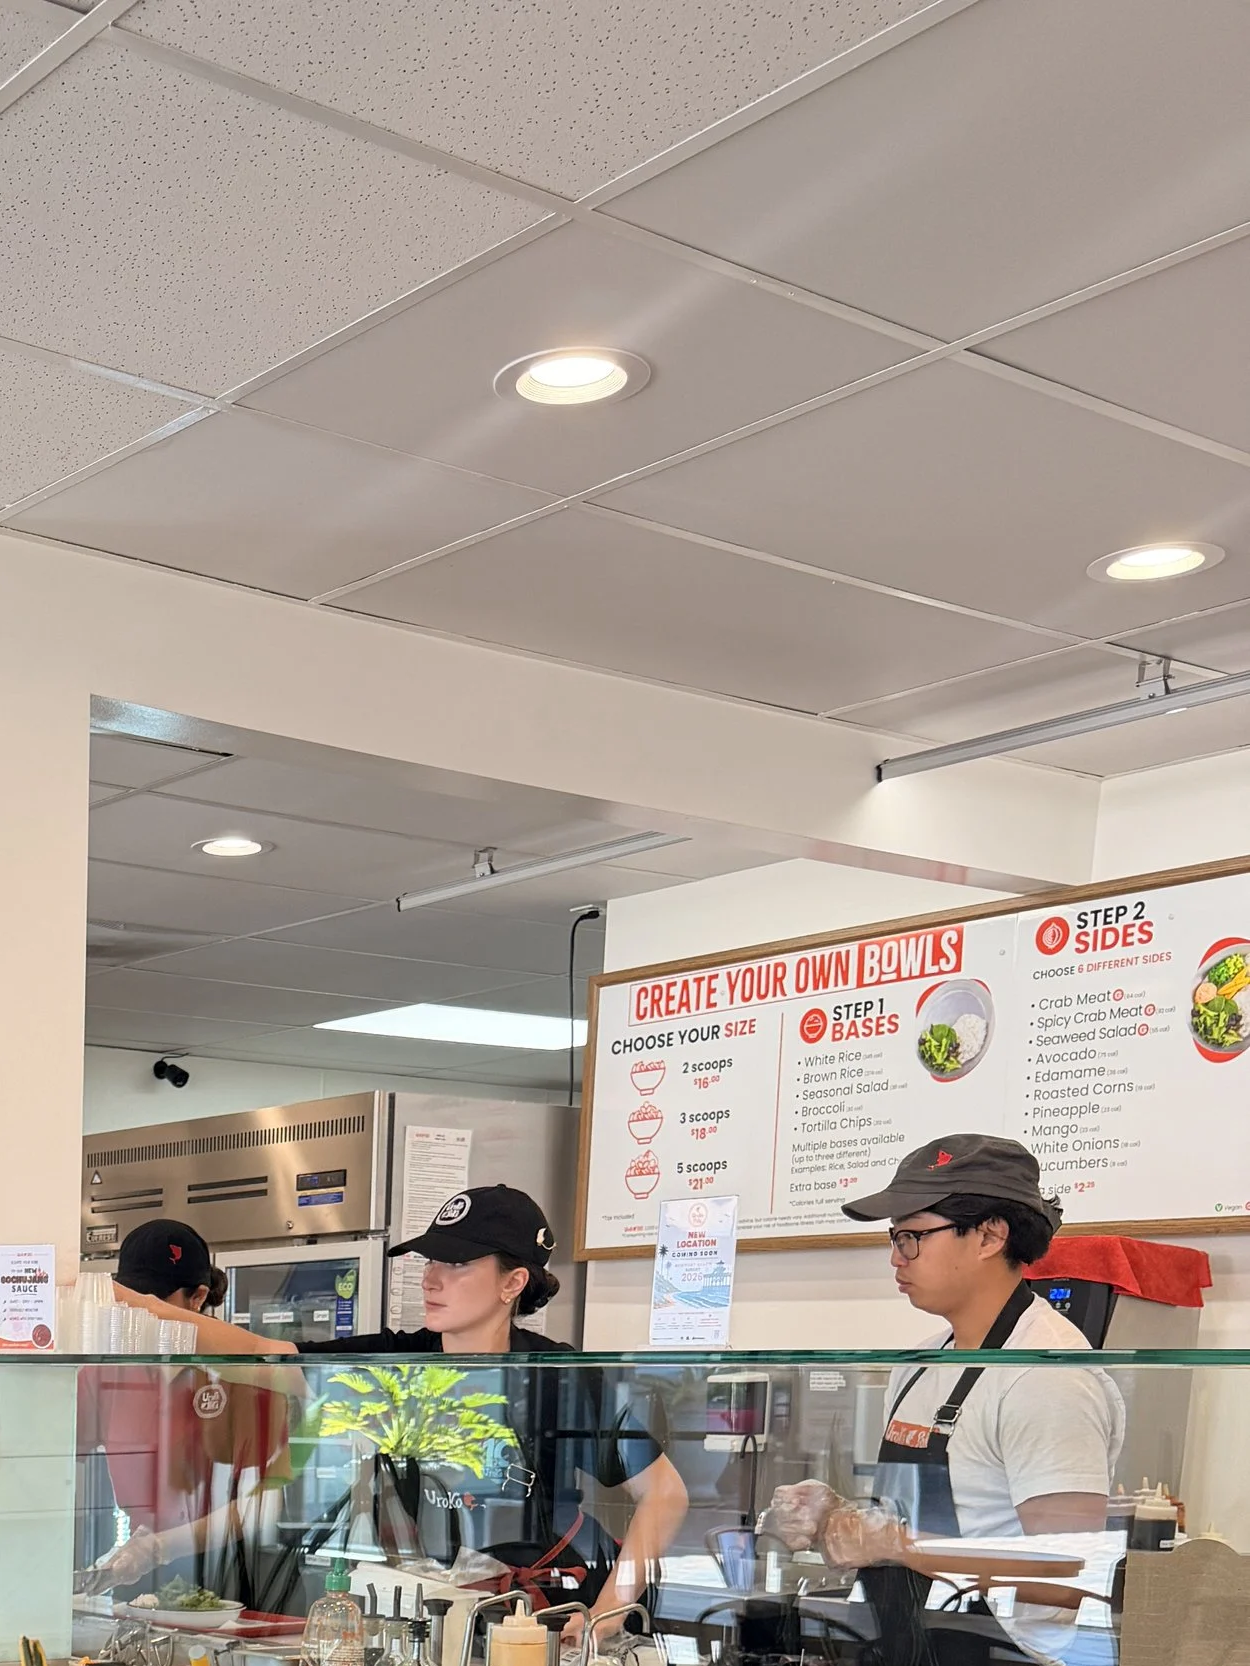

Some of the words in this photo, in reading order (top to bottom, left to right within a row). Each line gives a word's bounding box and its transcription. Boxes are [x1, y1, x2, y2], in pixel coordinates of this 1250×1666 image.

[1076, 905, 1127, 929] STEP
[1133, 901, 1145, 920] 2
[1074, 920, 1153, 954] SIDES
[1033, 965, 1075, 980] CHOOSE
[1078, 964, 1084, 973] 6
[1086, 956, 1140, 973] DIFFERENT
[1142, 951, 1172, 965] SIDES
[635, 973, 719, 1021] CREATE
[725, 962, 787, 1006] YOUR
[794, 948, 850, 993] OWN
[859, 929, 959, 983] BOWLS
[1038, 994, 1072, 1010] Crab
[1076, 990, 1111, 1005] Meat
[833, 1000, 875, 1021] STEP
[879, 998, 885, 1015] 1
[1037, 1014, 1071, 1031] Spicy
[1074, 1008, 1106, 1024] Crab
[1109, 1005, 1143, 1020] Meat
[611, 1031, 675, 1055] CHOOSE
[678, 1024, 721, 1044] YOUR
[724, 1018, 756, 1038] SIZE
[831, 1013, 900, 1043] BASES
[1036, 1028, 1096, 1047] Seaweed
[1099, 1023, 1137, 1039] Salad
[804, 1054, 835, 1067] White
[838, 1050, 862, 1063] Rice
[1035, 1047, 1097, 1065] Avocado
[682, 1063, 689, 1074] 2
[692, 1057, 733, 1077] scoops
[803, 1071, 837, 1084] Brown
[840, 1067, 864, 1080] Rice
[1035, 1066, 1106, 1083] Edamame
[693, 1075, 720, 1090] $16.00
[802, 1084, 853, 1100] Seasonal
[856, 1079, 889, 1094] Salad
[1034, 1084, 1089, 1101] Roasted
[1092, 1081, 1134, 1096] Corns
[801, 1101, 845, 1117] Broccoli
[1033, 1101, 1100, 1119] Pineapple
[680, 1112, 686, 1124] 3
[689, 1109, 730, 1127] scoops
[801, 1120, 837, 1133] Tortilla
[840, 1116, 872, 1131] Chips
[690, 1126, 717, 1141] $18.00
[1031, 1123, 1078, 1138] Mango
[792, 1140, 827, 1153] Multiple
[830, 1138, 858, 1149] bases
[860, 1133, 905, 1146] available
[1031, 1141, 1069, 1154] White
[1072, 1137, 1120, 1152] Onions
[791, 1154, 804, 1165] (up
[806, 1153, 813, 1162] to
[815, 1151, 834, 1160] three
[836, 1147, 871, 1160] different)
[1040, 1157, 1108, 1172] ucumbers
[677, 1162, 684, 1174] 5
[686, 1160, 728, 1175] scoops
[791, 1163, 826, 1174] Examples:
[847, 1159, 868, 1169] Salad
[871, 1158, 886, 1167] and
[688, 1176, 714, 1191] $21.00
[790, 1182, 812, 1192] Extra
[814, 1180, 837, 1190] base
[1048, 1183, 1071, 1195] side
[688, 1231, 706, 1239] NEW
[676, 1239, 717, 1249] LOCATION
[681, 1272, 703, 1282] 2026
[11, 1285, 38, 1293] SAUCE
